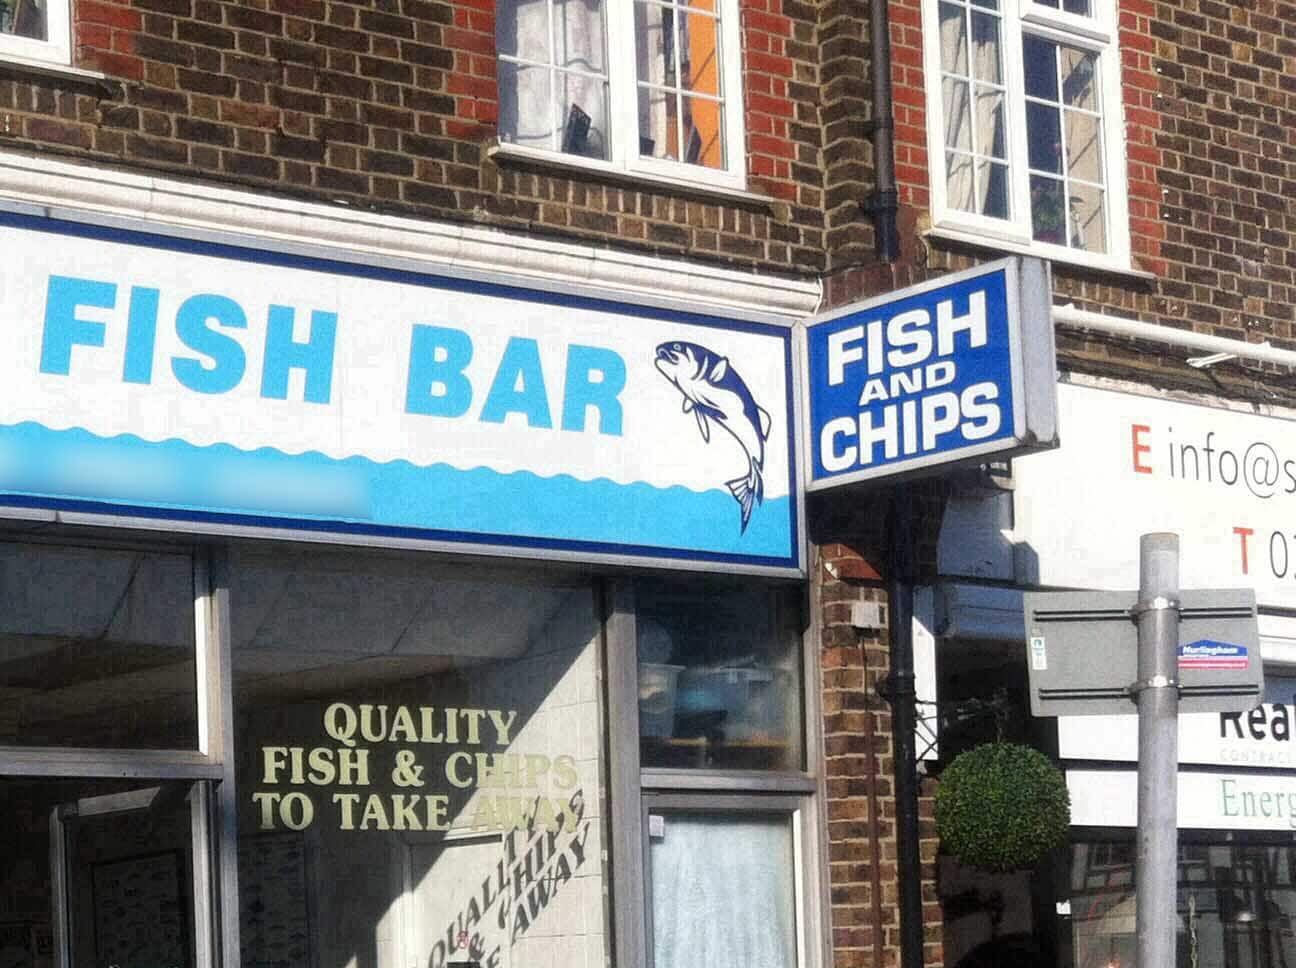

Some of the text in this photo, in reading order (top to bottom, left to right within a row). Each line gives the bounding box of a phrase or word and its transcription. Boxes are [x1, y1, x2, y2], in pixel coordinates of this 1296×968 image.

[39, 275, 627, 437] FISH BAR
[828, 290, 987, 386] FISH
[859, 361, 956, 405] AND
[820, 382, 1001, 472] CHIPS
[1132, 424, 1152, 474] E
[1233, 527, 1296, 578] T 0
[324, 703, 517, 746] QUALITY
[262, 747, 578, 789] FISH & CHIPS
[253, 792, 577, 832] TO TAKE AWAY
